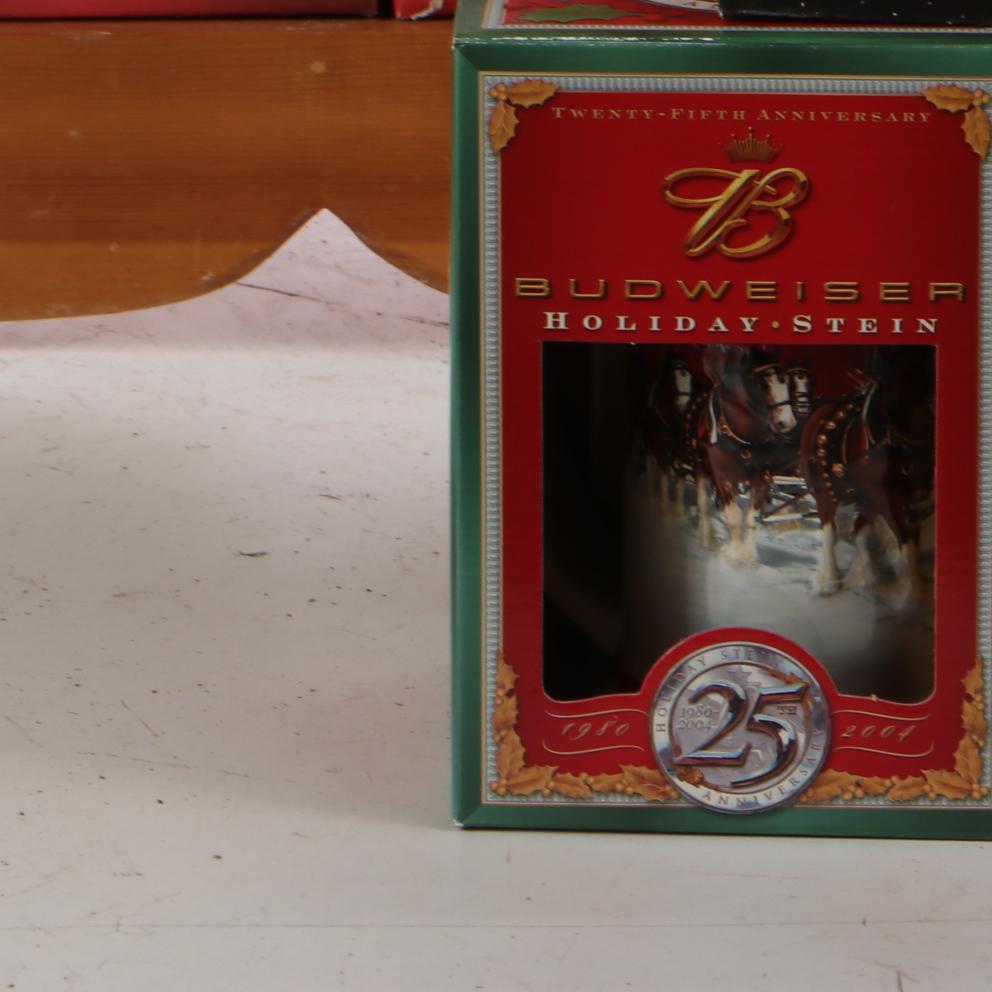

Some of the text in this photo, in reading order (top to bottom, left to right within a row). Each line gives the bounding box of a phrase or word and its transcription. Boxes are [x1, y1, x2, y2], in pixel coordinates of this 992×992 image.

[552, 107, 933, 123] TWENTY-FIFTH ANNIVERSARY
[514, 276, 967, 303] BUDWEISER
[560, 714, 631, 742] 1980
[673, 678, 813, 790] 25
